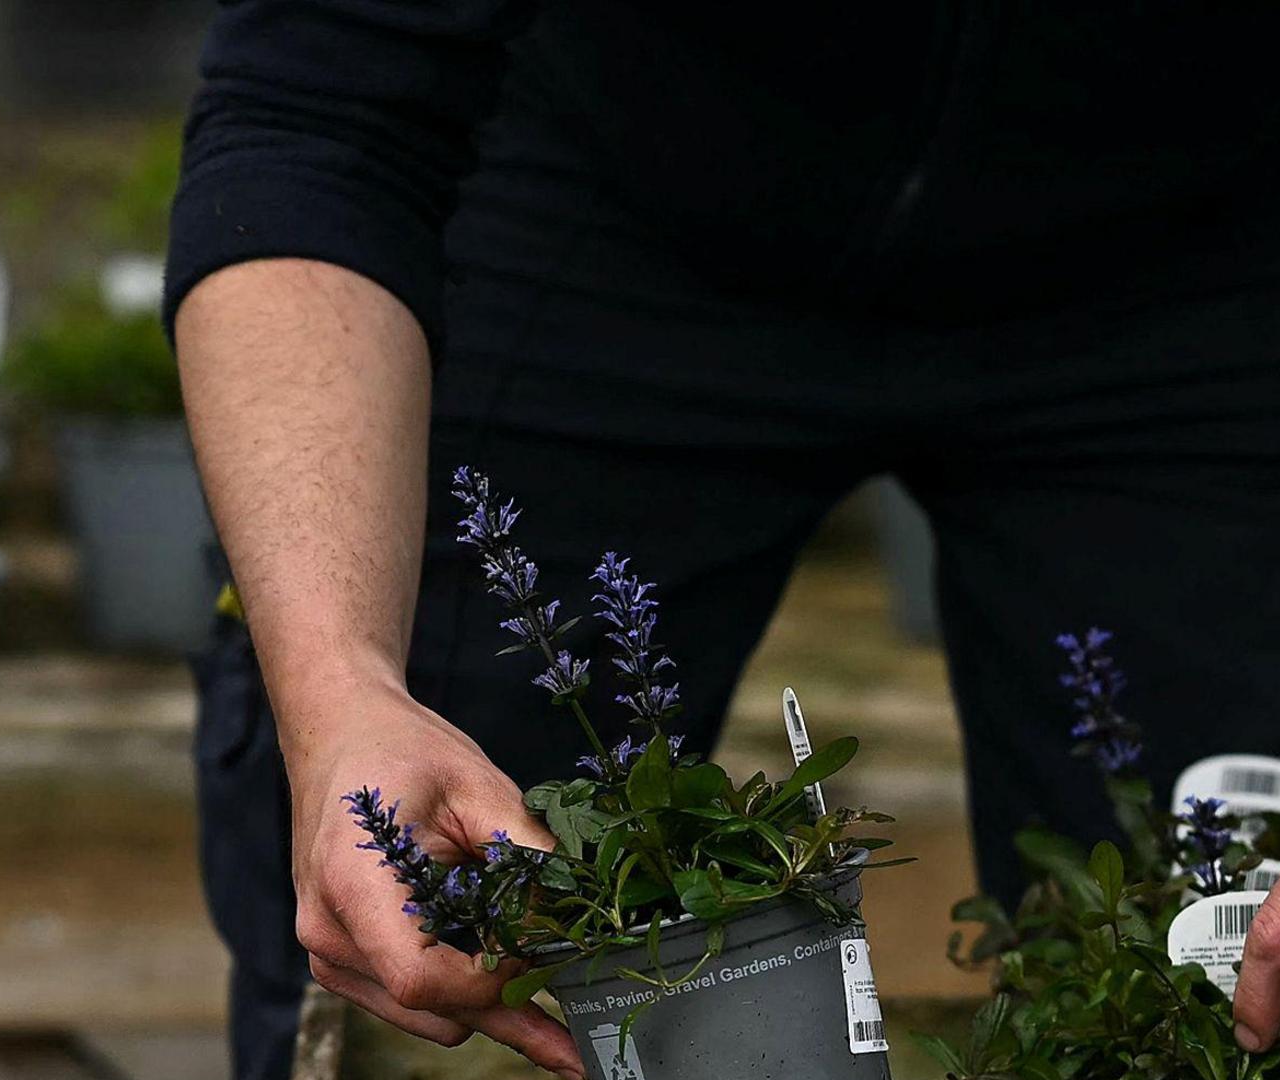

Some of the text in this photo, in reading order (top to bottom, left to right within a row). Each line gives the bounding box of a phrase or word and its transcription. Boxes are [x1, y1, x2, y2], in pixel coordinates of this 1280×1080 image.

[570, 999, 606, 1015] Banks,
[663, 972, 716, 996] Gravel
[719, 952, 792, 984] Gardens,
